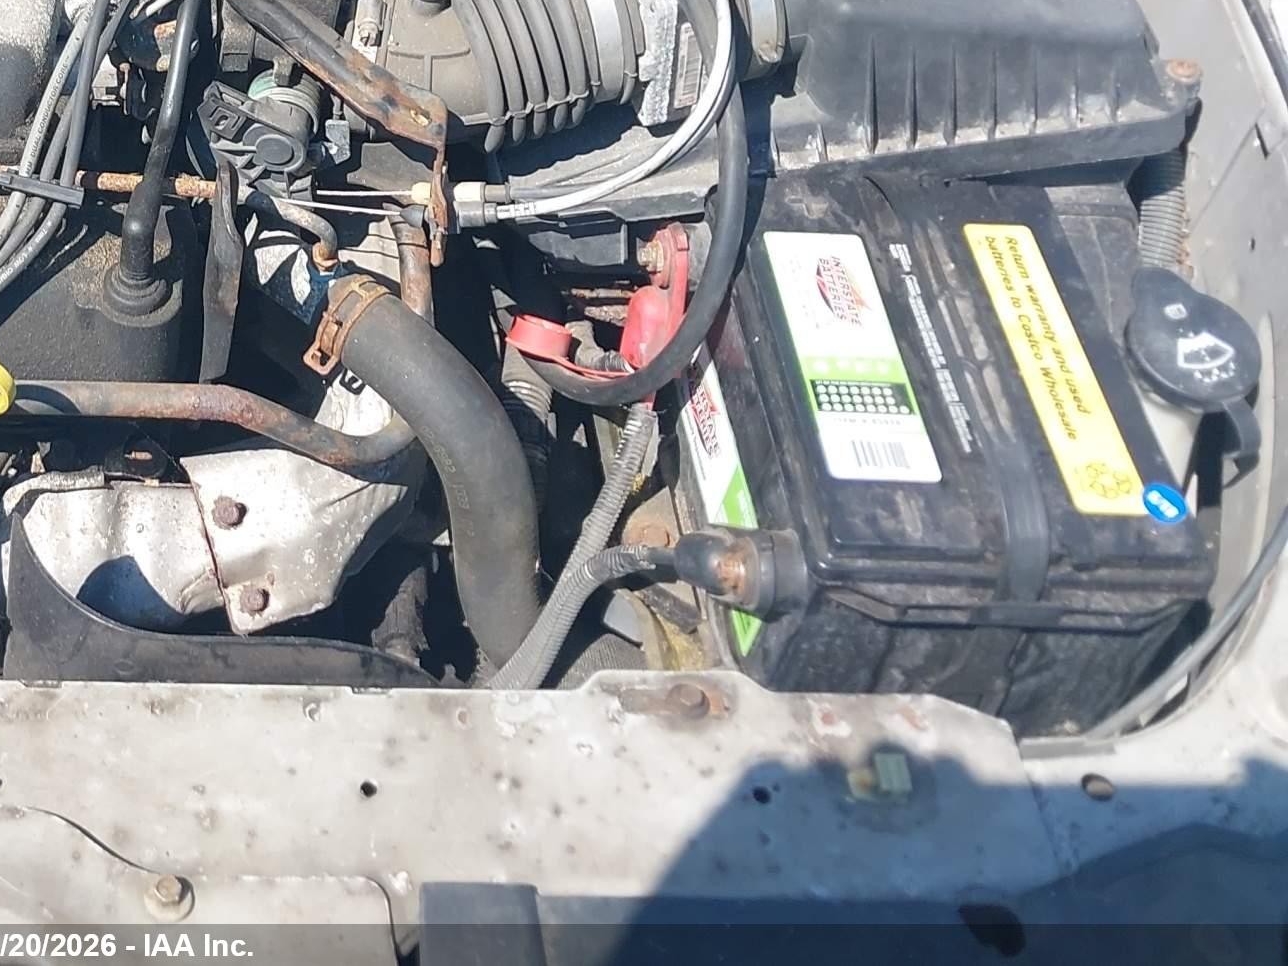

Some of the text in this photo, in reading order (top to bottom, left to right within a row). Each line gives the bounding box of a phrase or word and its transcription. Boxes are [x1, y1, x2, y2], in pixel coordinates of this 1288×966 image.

[30, 136, 42, 159] DUAL
[38, 85, 59, 136] CONDUCTOR
[818, 257, 849, 321] BATTERIES
[830, 255, 862, 326] INTERSTATE
[1004, 235, 1091, 415] Return warranty and used
[985, 235, 1077, 441] batteries to Costco Wholesale
